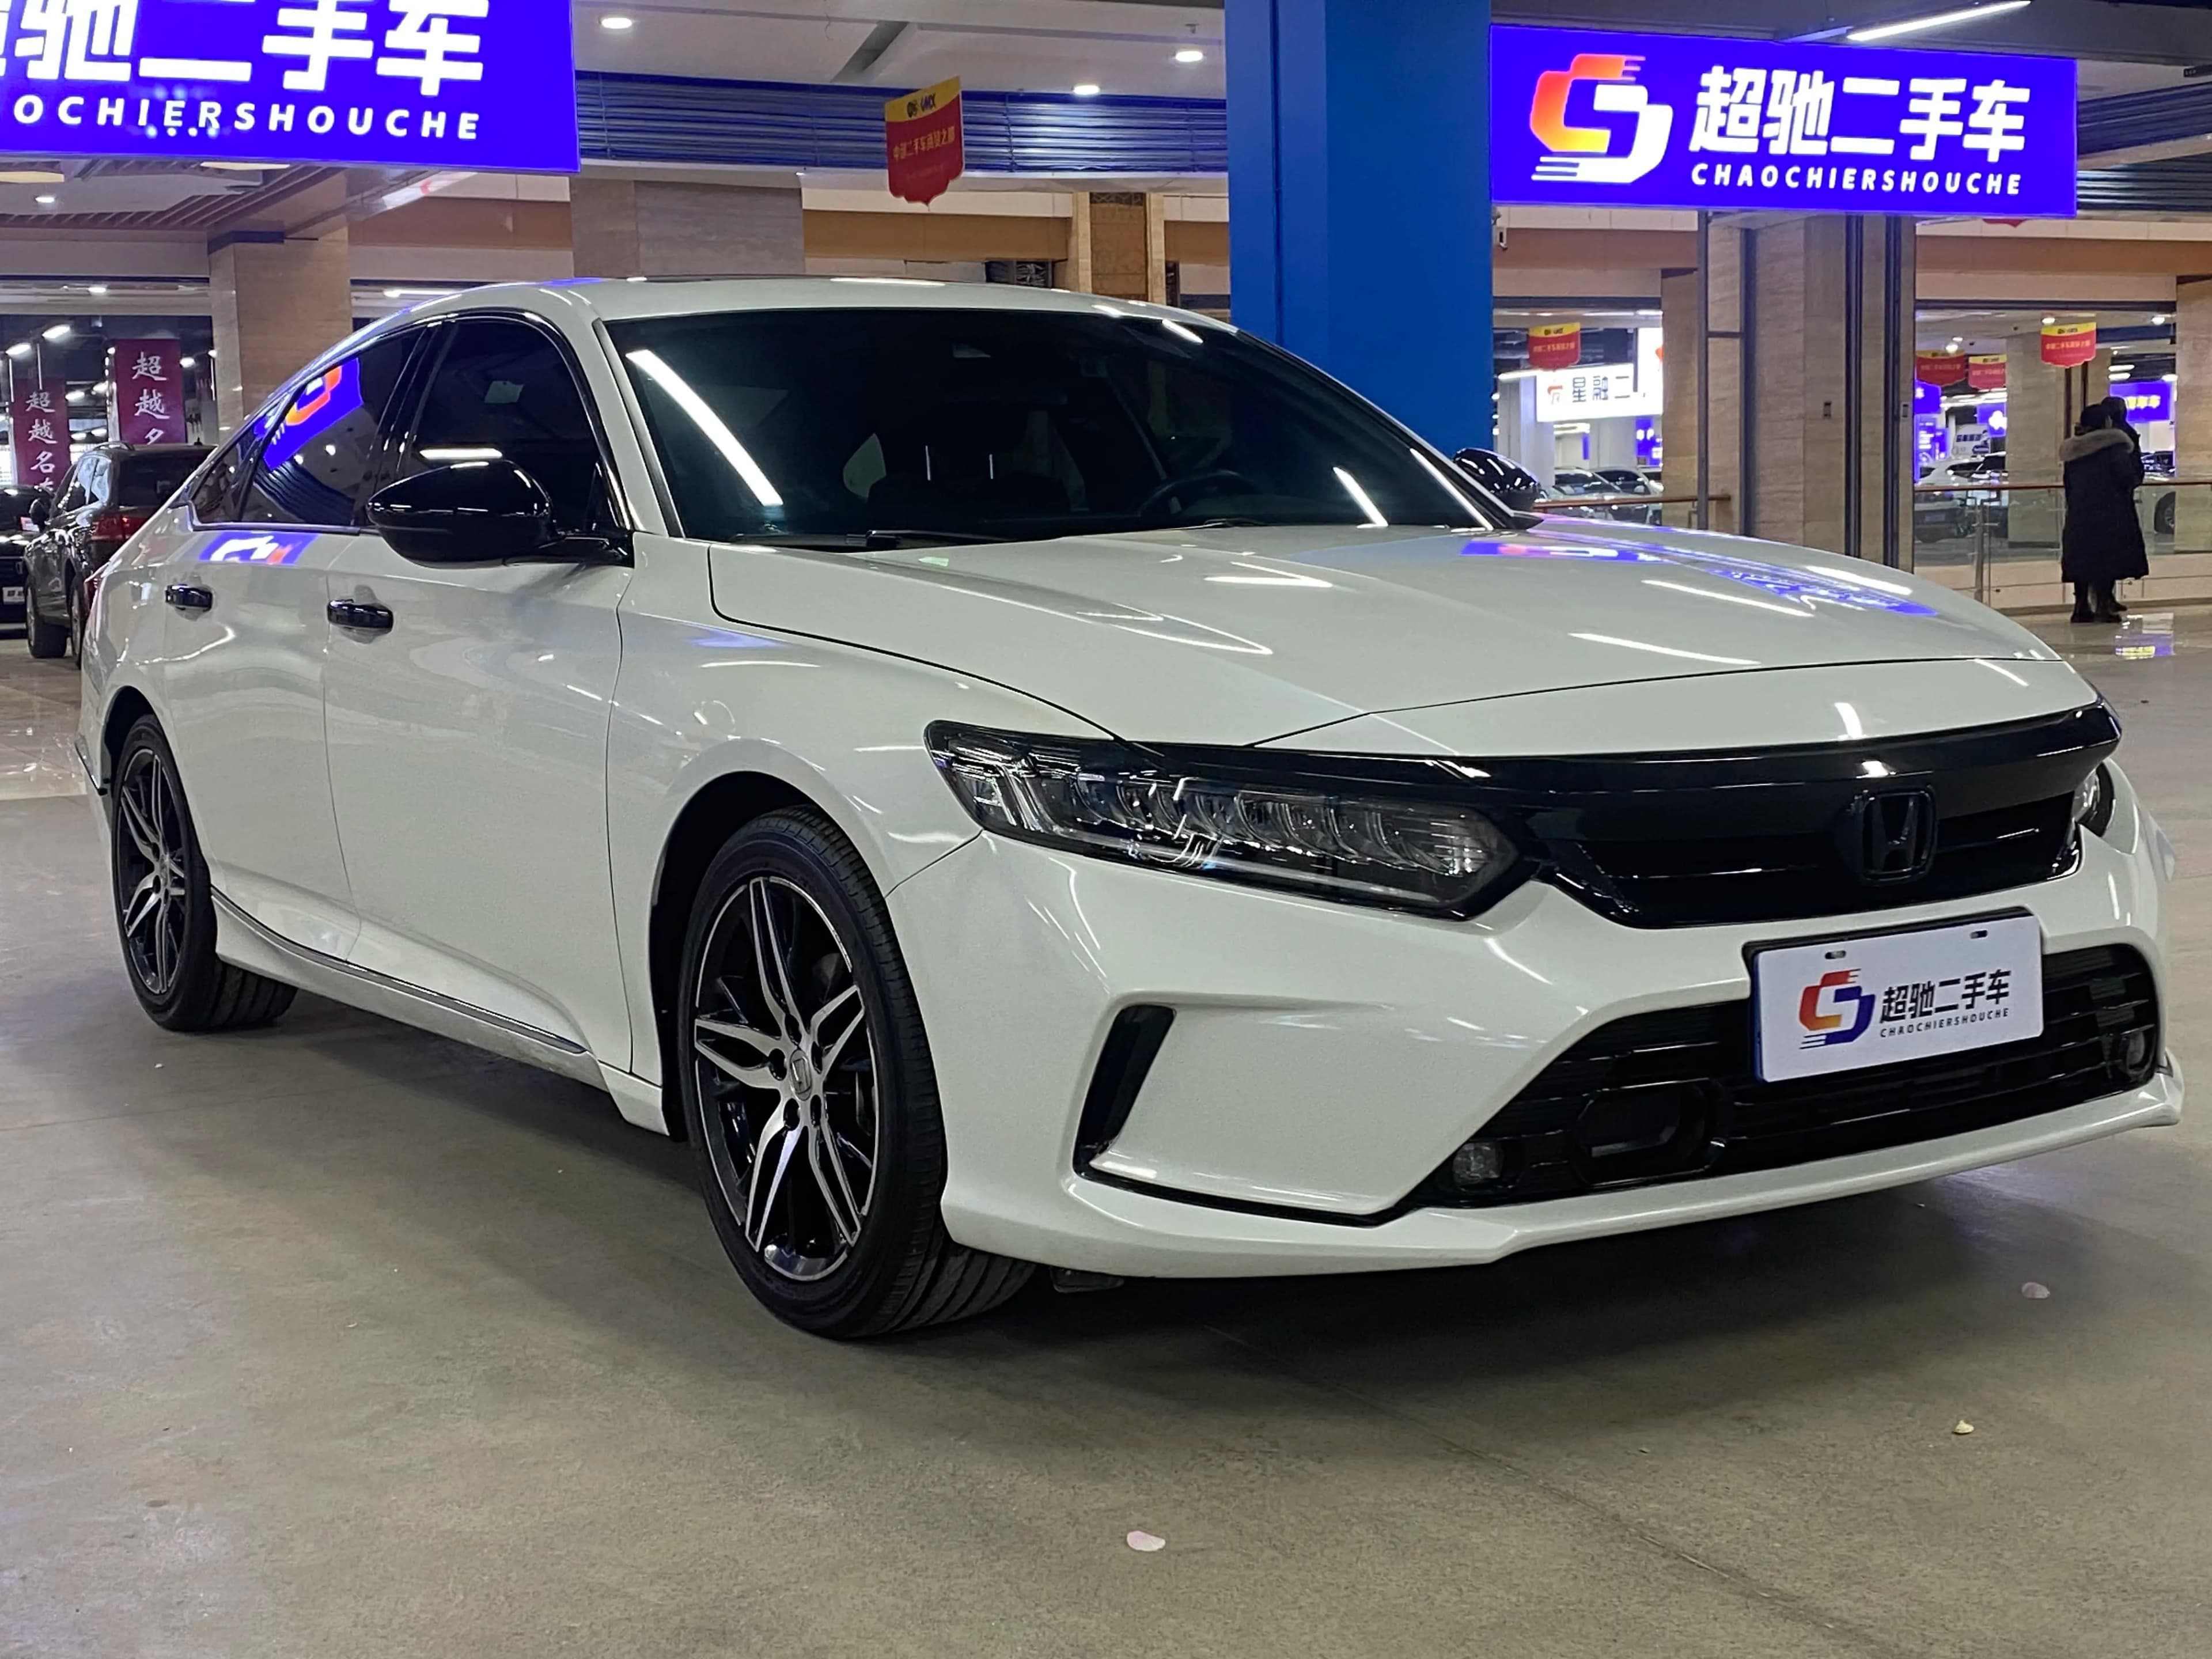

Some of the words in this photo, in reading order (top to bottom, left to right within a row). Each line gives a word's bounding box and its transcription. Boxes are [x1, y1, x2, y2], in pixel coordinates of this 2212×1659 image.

[0, 0, 488, 96] 驰二手车
[13, 94, 479, 139] OCHIERSHOUCHE
[1689, 65, 2031, 162] 超驰二手车
[1691, 162, 2021, 195] CHAOCHIERSHOUCHE
[1879, 969, 2012, 1024] 超驰二手车
[1880, 1007, 2009, 1037] CHAOCHIERSHOUCHE
